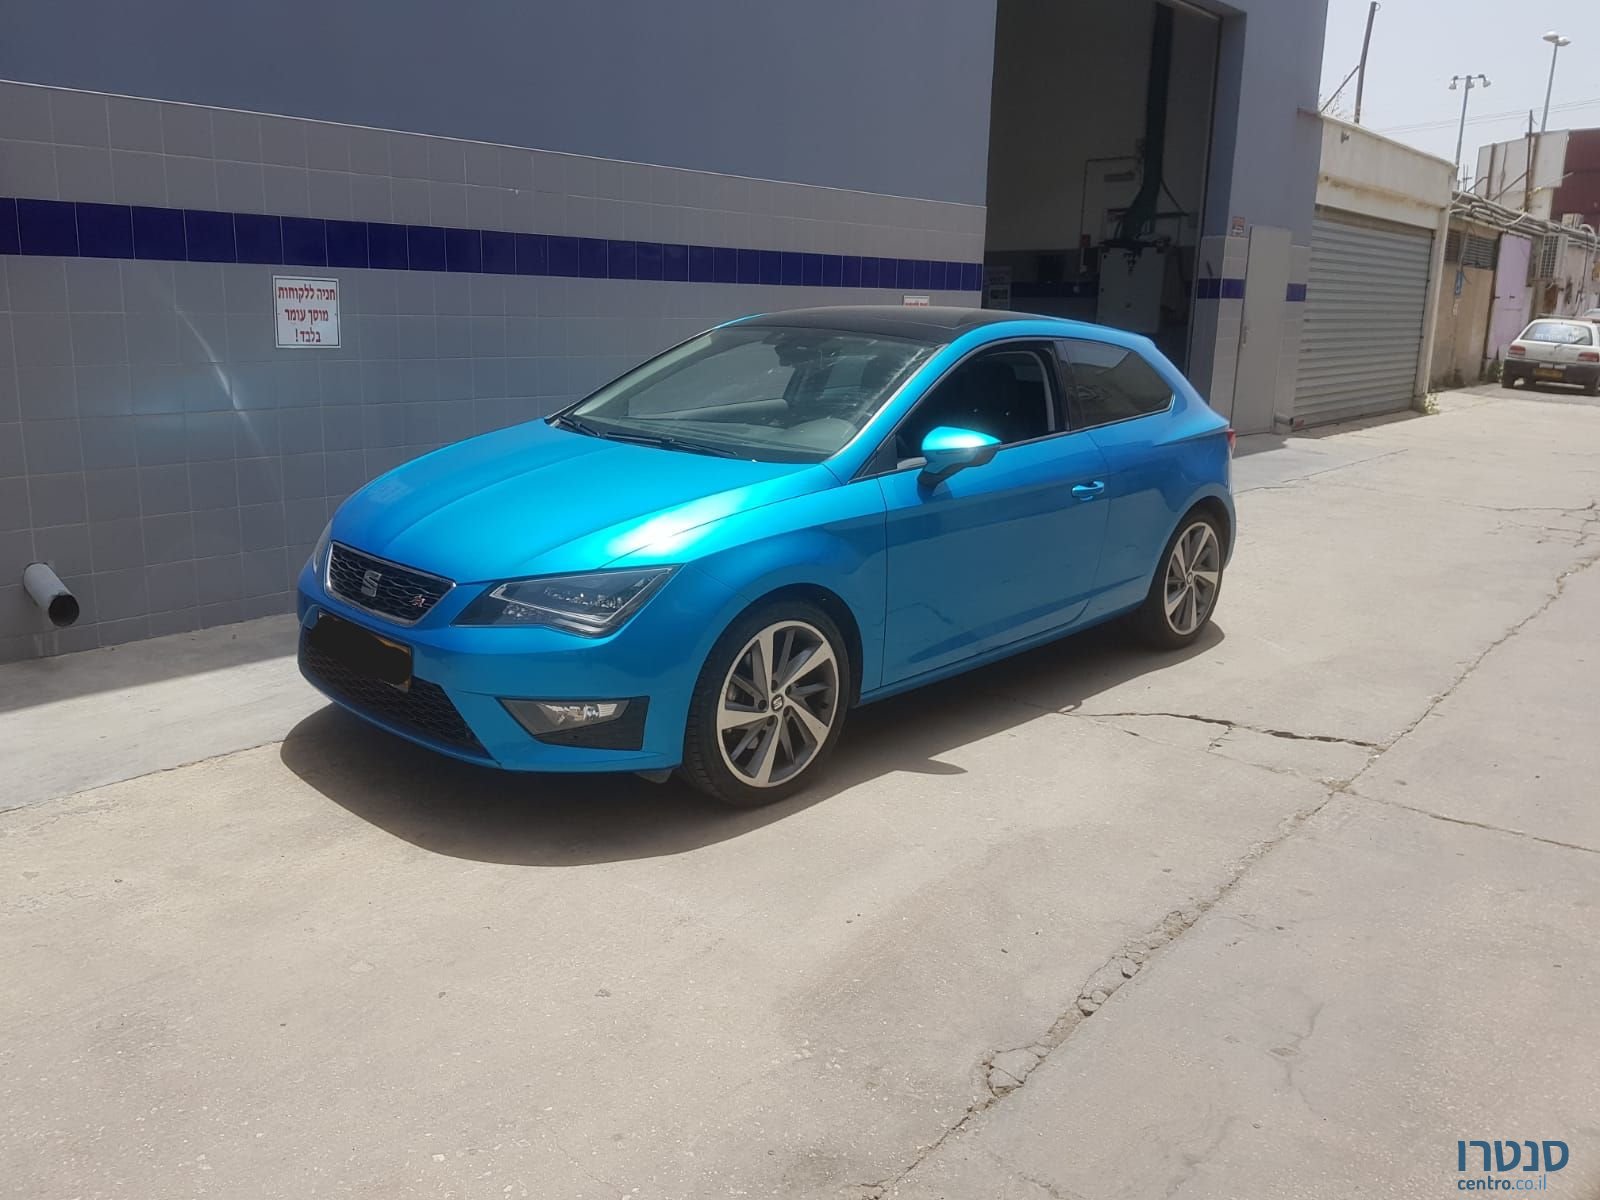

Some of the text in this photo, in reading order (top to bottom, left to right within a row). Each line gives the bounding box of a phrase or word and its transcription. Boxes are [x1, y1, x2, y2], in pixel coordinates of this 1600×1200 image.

[278, 283, 336, 303] חניה ללקוחות
[307, 309, 329, 325] מוסך
